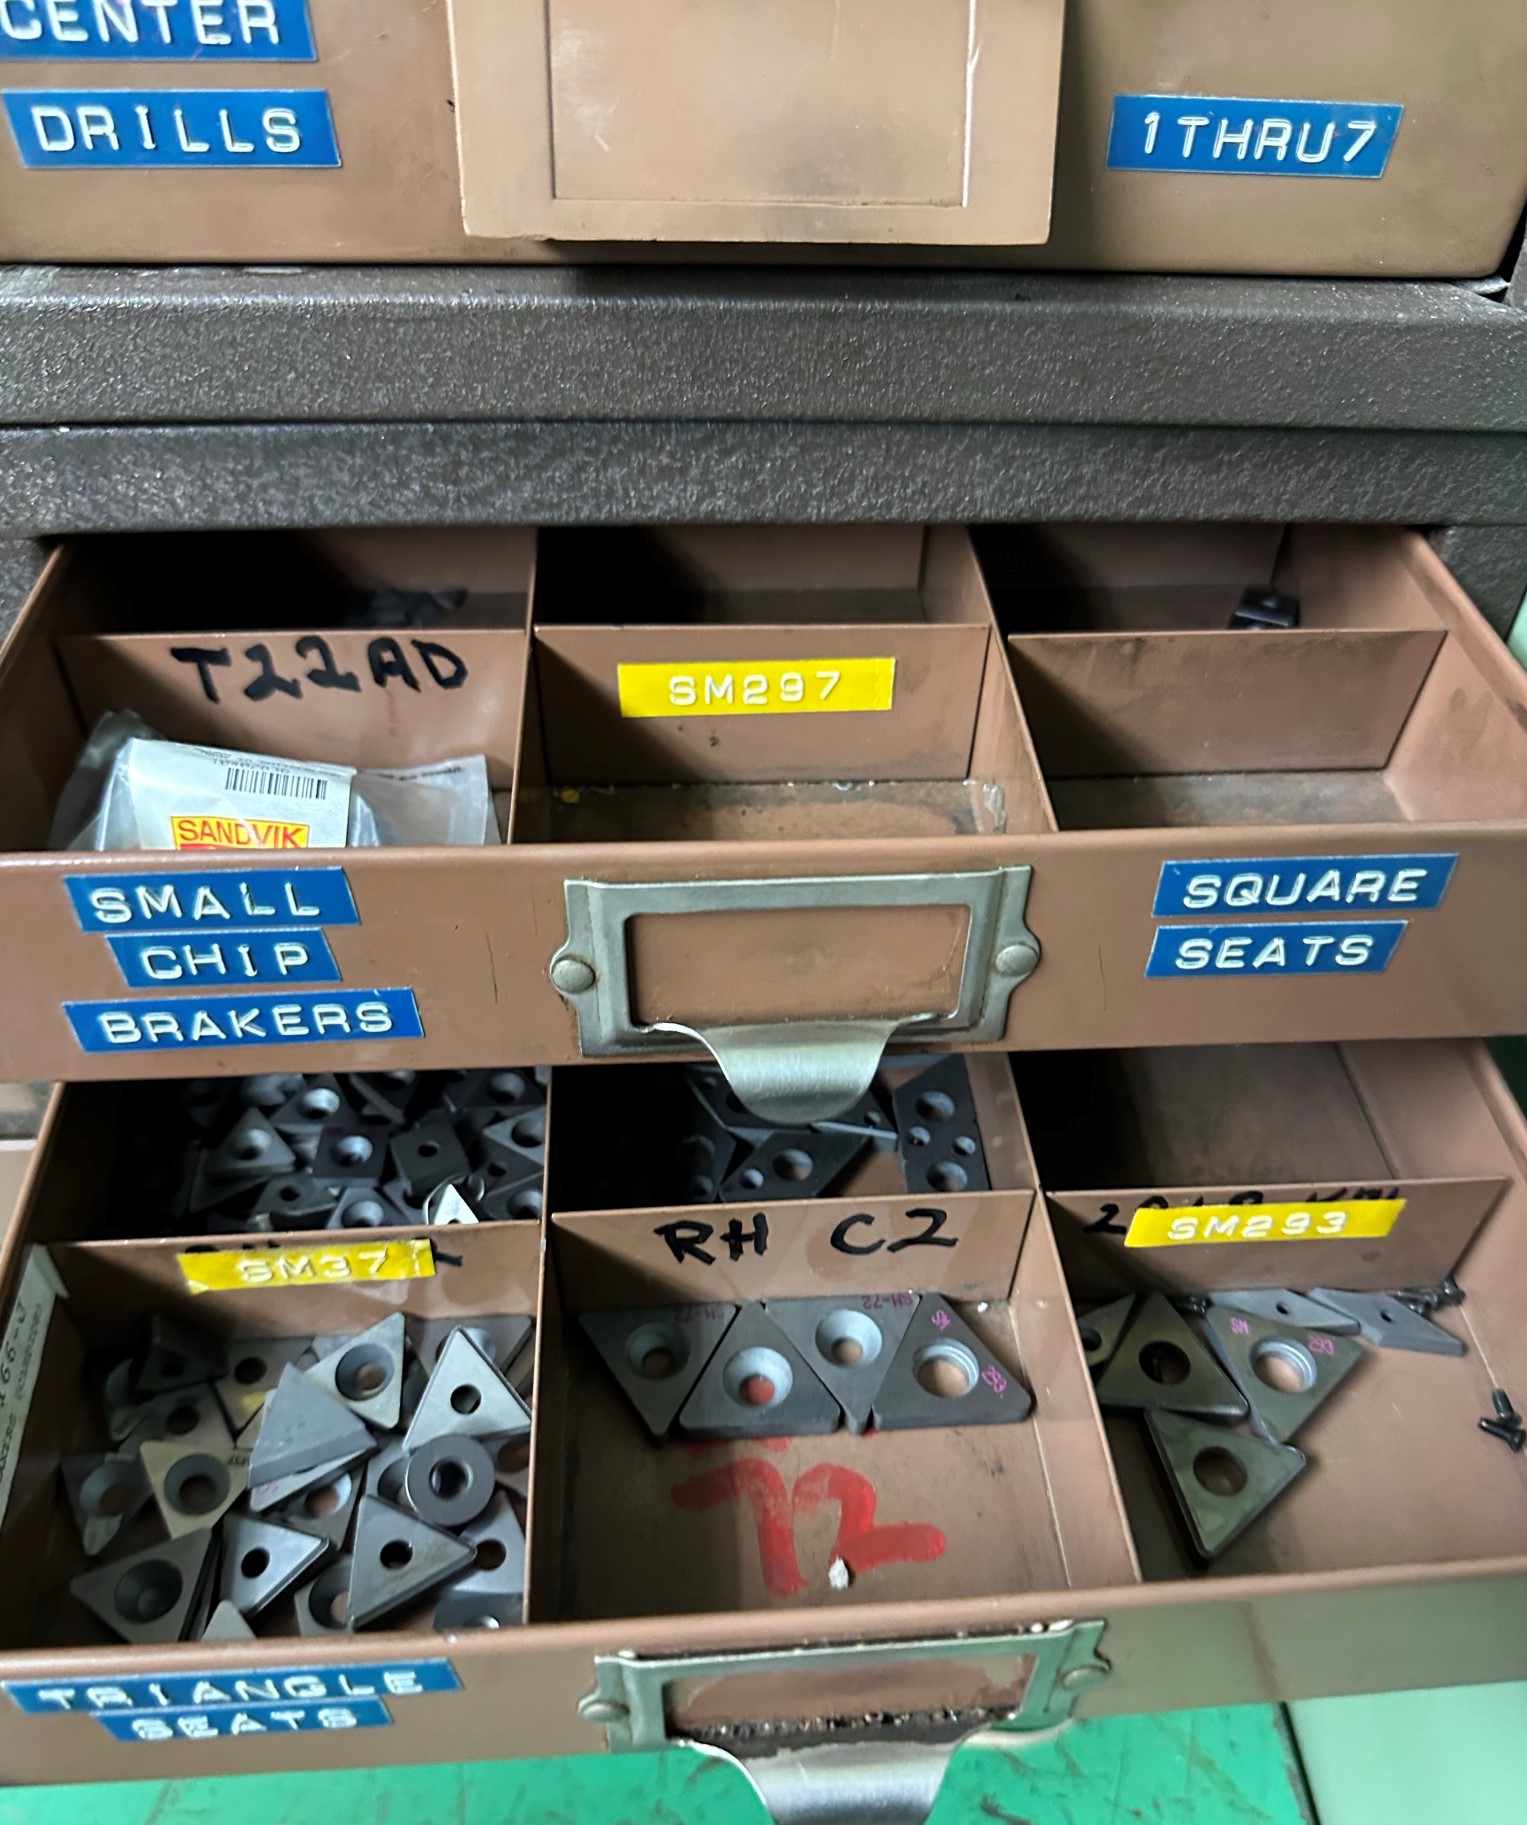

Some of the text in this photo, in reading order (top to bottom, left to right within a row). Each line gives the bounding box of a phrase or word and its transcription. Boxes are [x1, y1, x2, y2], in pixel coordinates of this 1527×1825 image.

[0, 0, 280, 45] CENTER
[31, 104, 301, 153] DRILLS
[668, 670, 841, 706] SM297
[177, 819, 303, 849] SANDVIK
[90, 882, 321, 924] SMALL
[1182, 868, 1428, 909] SQUARE
[141, 942, 310, 980] CHIP
[1175, 934, 1375, 970] SEATS
[101, 1002, 395, 1045] BRAKERS
[654, 1207, 959, 1266] RH C2
[1167, 1210, 1348, 1241] SM293
[236, 1246, 389, 1284] SM37
[37, 1670, 424, 1711] TRIANGLE
[131, 1707, 357, 1741] SEATS
